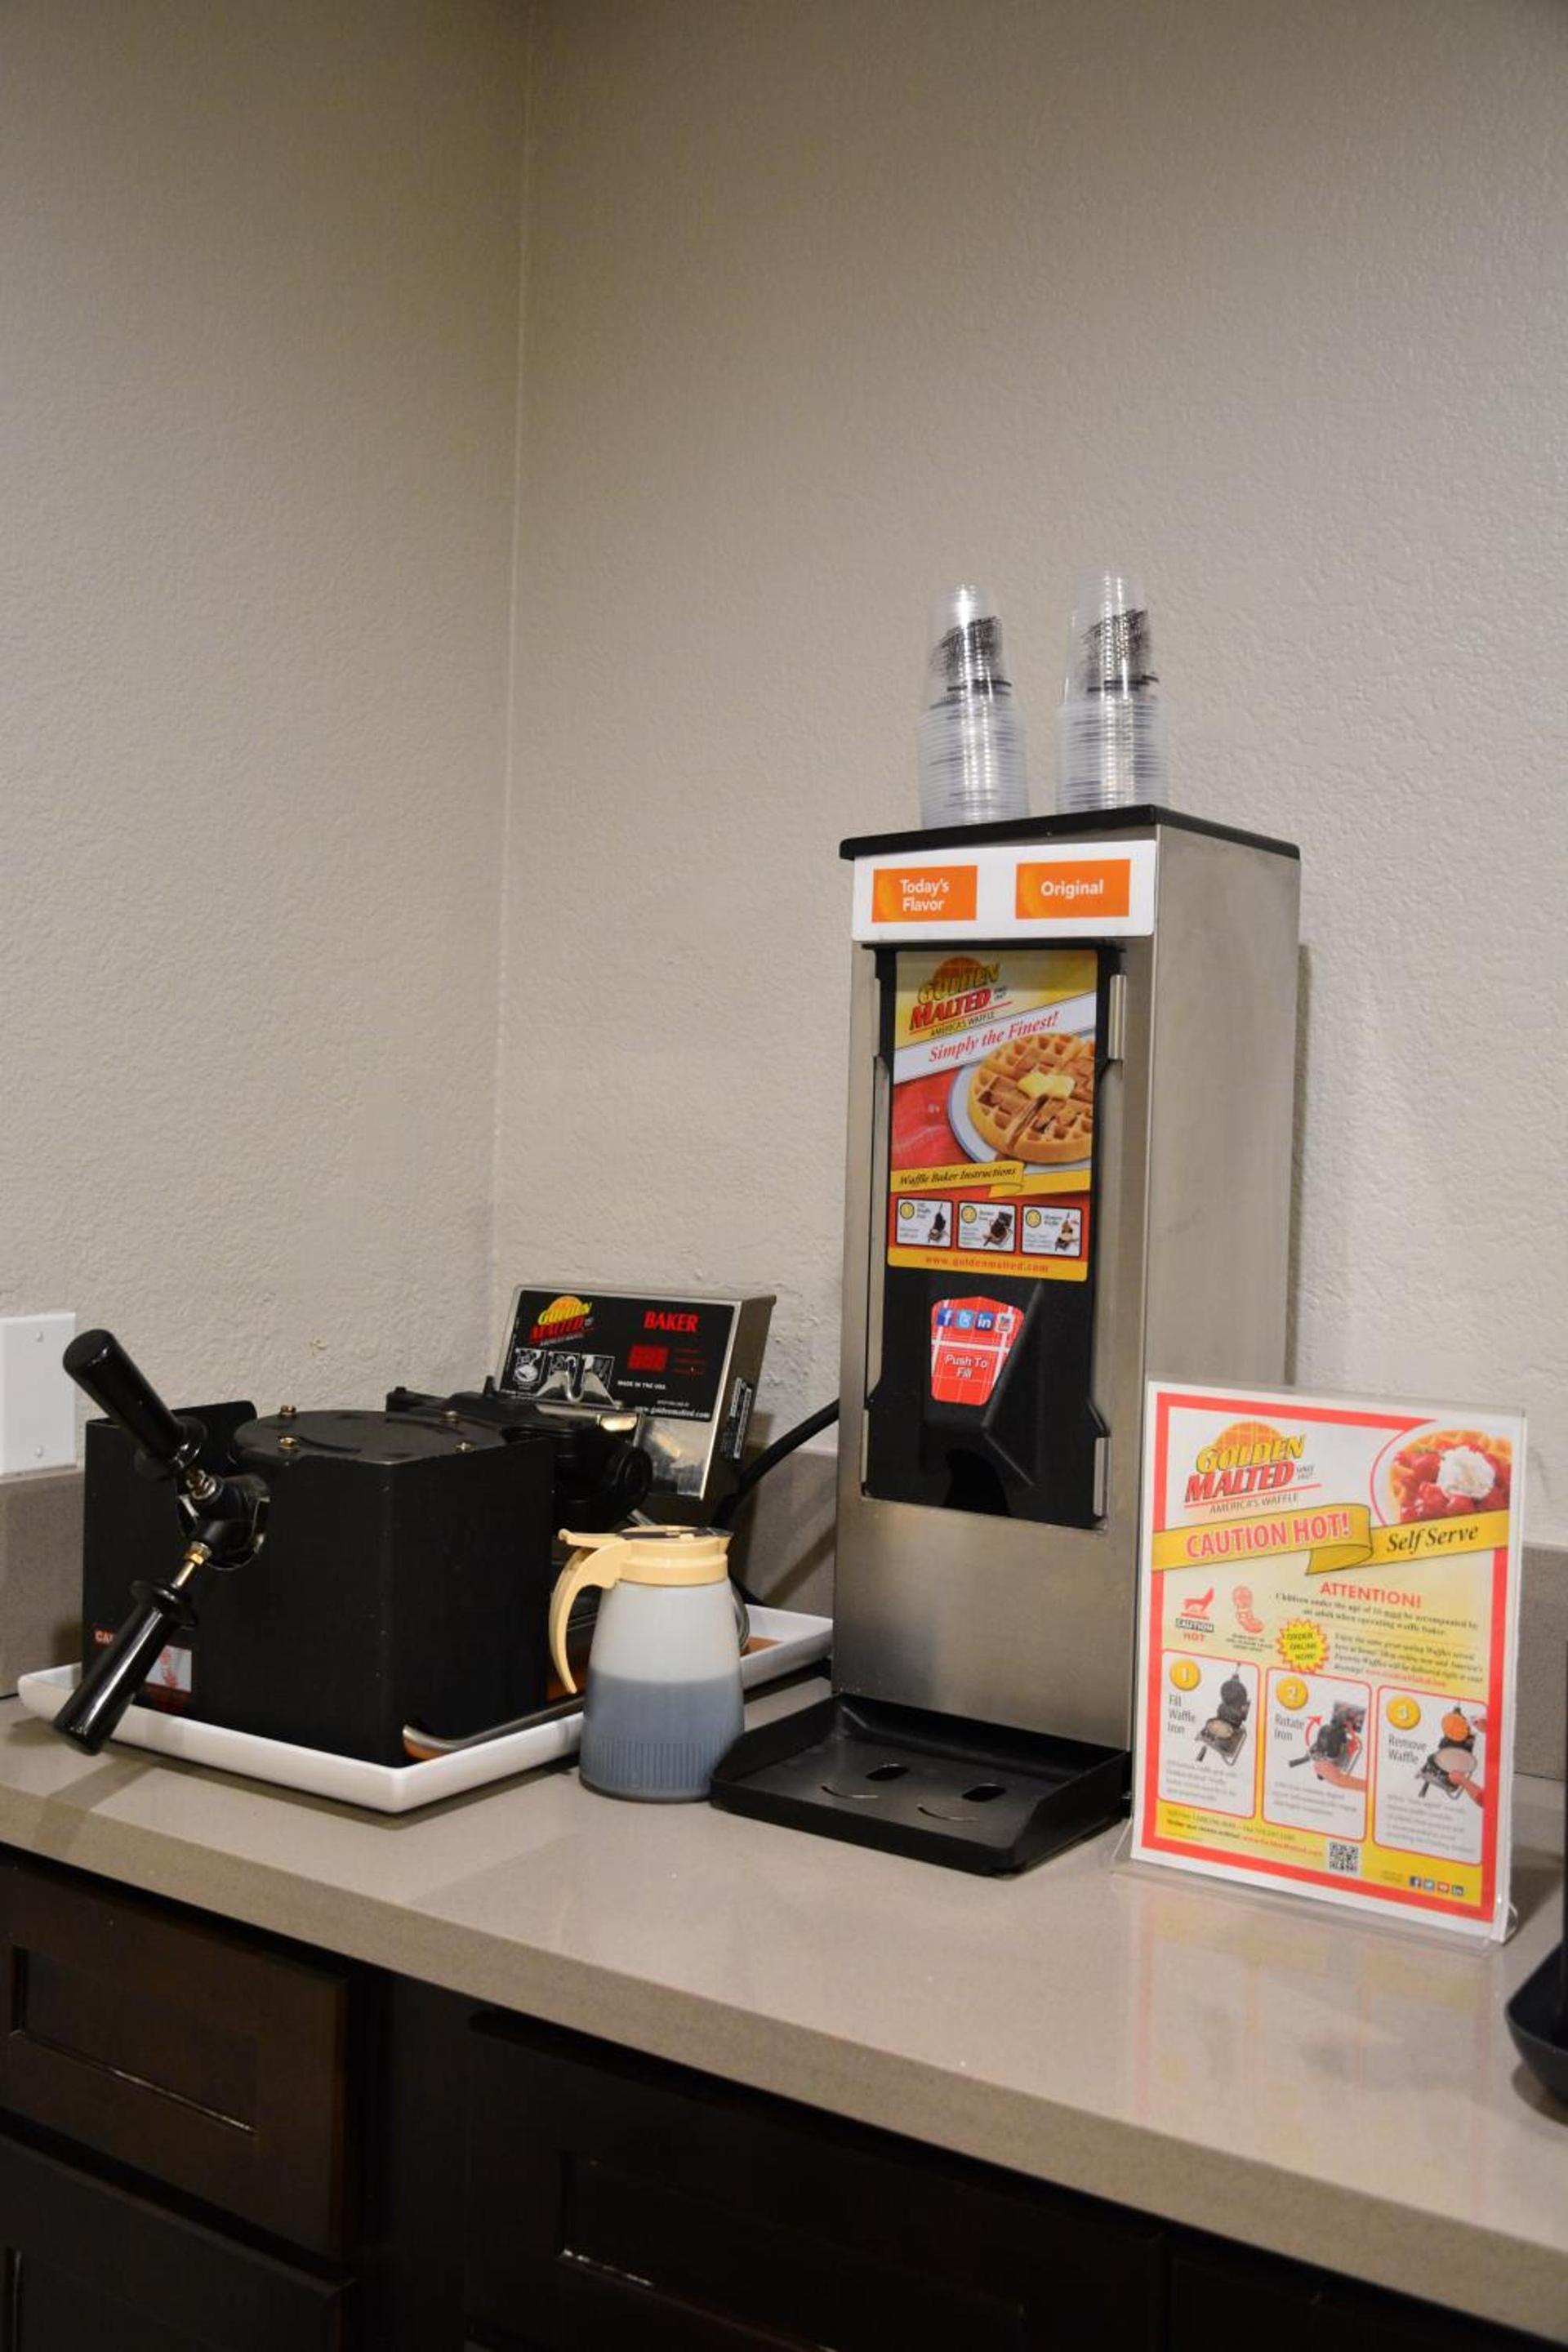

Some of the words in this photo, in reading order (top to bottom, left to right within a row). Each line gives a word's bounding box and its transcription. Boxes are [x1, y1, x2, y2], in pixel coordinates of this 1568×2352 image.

[900, 878, 950, 896] Today's
[1040, 879, 1104, 898] Original
[902, 898, 944, 912] Flavor
[917, 963, 1000, 1005] GOLDEN
[909, 987, 991, 1030] MALTED
[929, 1035, 978, 1062] Simply
[982, 1029, 1004, 1047] the
[1008, 1010, 1059, 1039] Finest!
[900, 1174, 929, 1186] Waffle
[931, 1172, 958, 1183] Baker
[960, 1166, 1017, 1181] Instructions
[644, 1310, 698, 1333] BAKER
[946, 1354, 972, 1366] Push
[975, 1357, 987, 1368] To
[957, 1367, 972, 1379] Fill
[1196, 1434, 1305, 1474] GOLDEN
[1186, 1460, 1295, 1503] MALTED
[1209, 1499, 1260, 1514] AMERICA'S
[1262, 1492, 1298, 1506] WAFFLE
[1186, 1523, 1288, 1559] CAUTION
[1294, 1512, 1352, 1542] HOT!
[1387, 1526, 1427, 1556] Self
[1428, 1524, 1479, 1548] Serve
[1320, 1580, 1422, 1609] ATTENTION!
[1178, 1619, 1214, 1633] CAUTION
[1184, 1633, 1205, 1642] HOT
[1286, 1633, 1313, 1641] ORDER
[1169, 1695, 1182, 1707] Fill
[1168, 1709, 1196, 1724] Waffle
[1275, 1713, 1305, 1730] Rotate
[1167, 1722, 1185, 1735] Iron
[1388, 1734, 1428, 1753] Remove
[1388, 1748, 1419, 1765] Waffle
